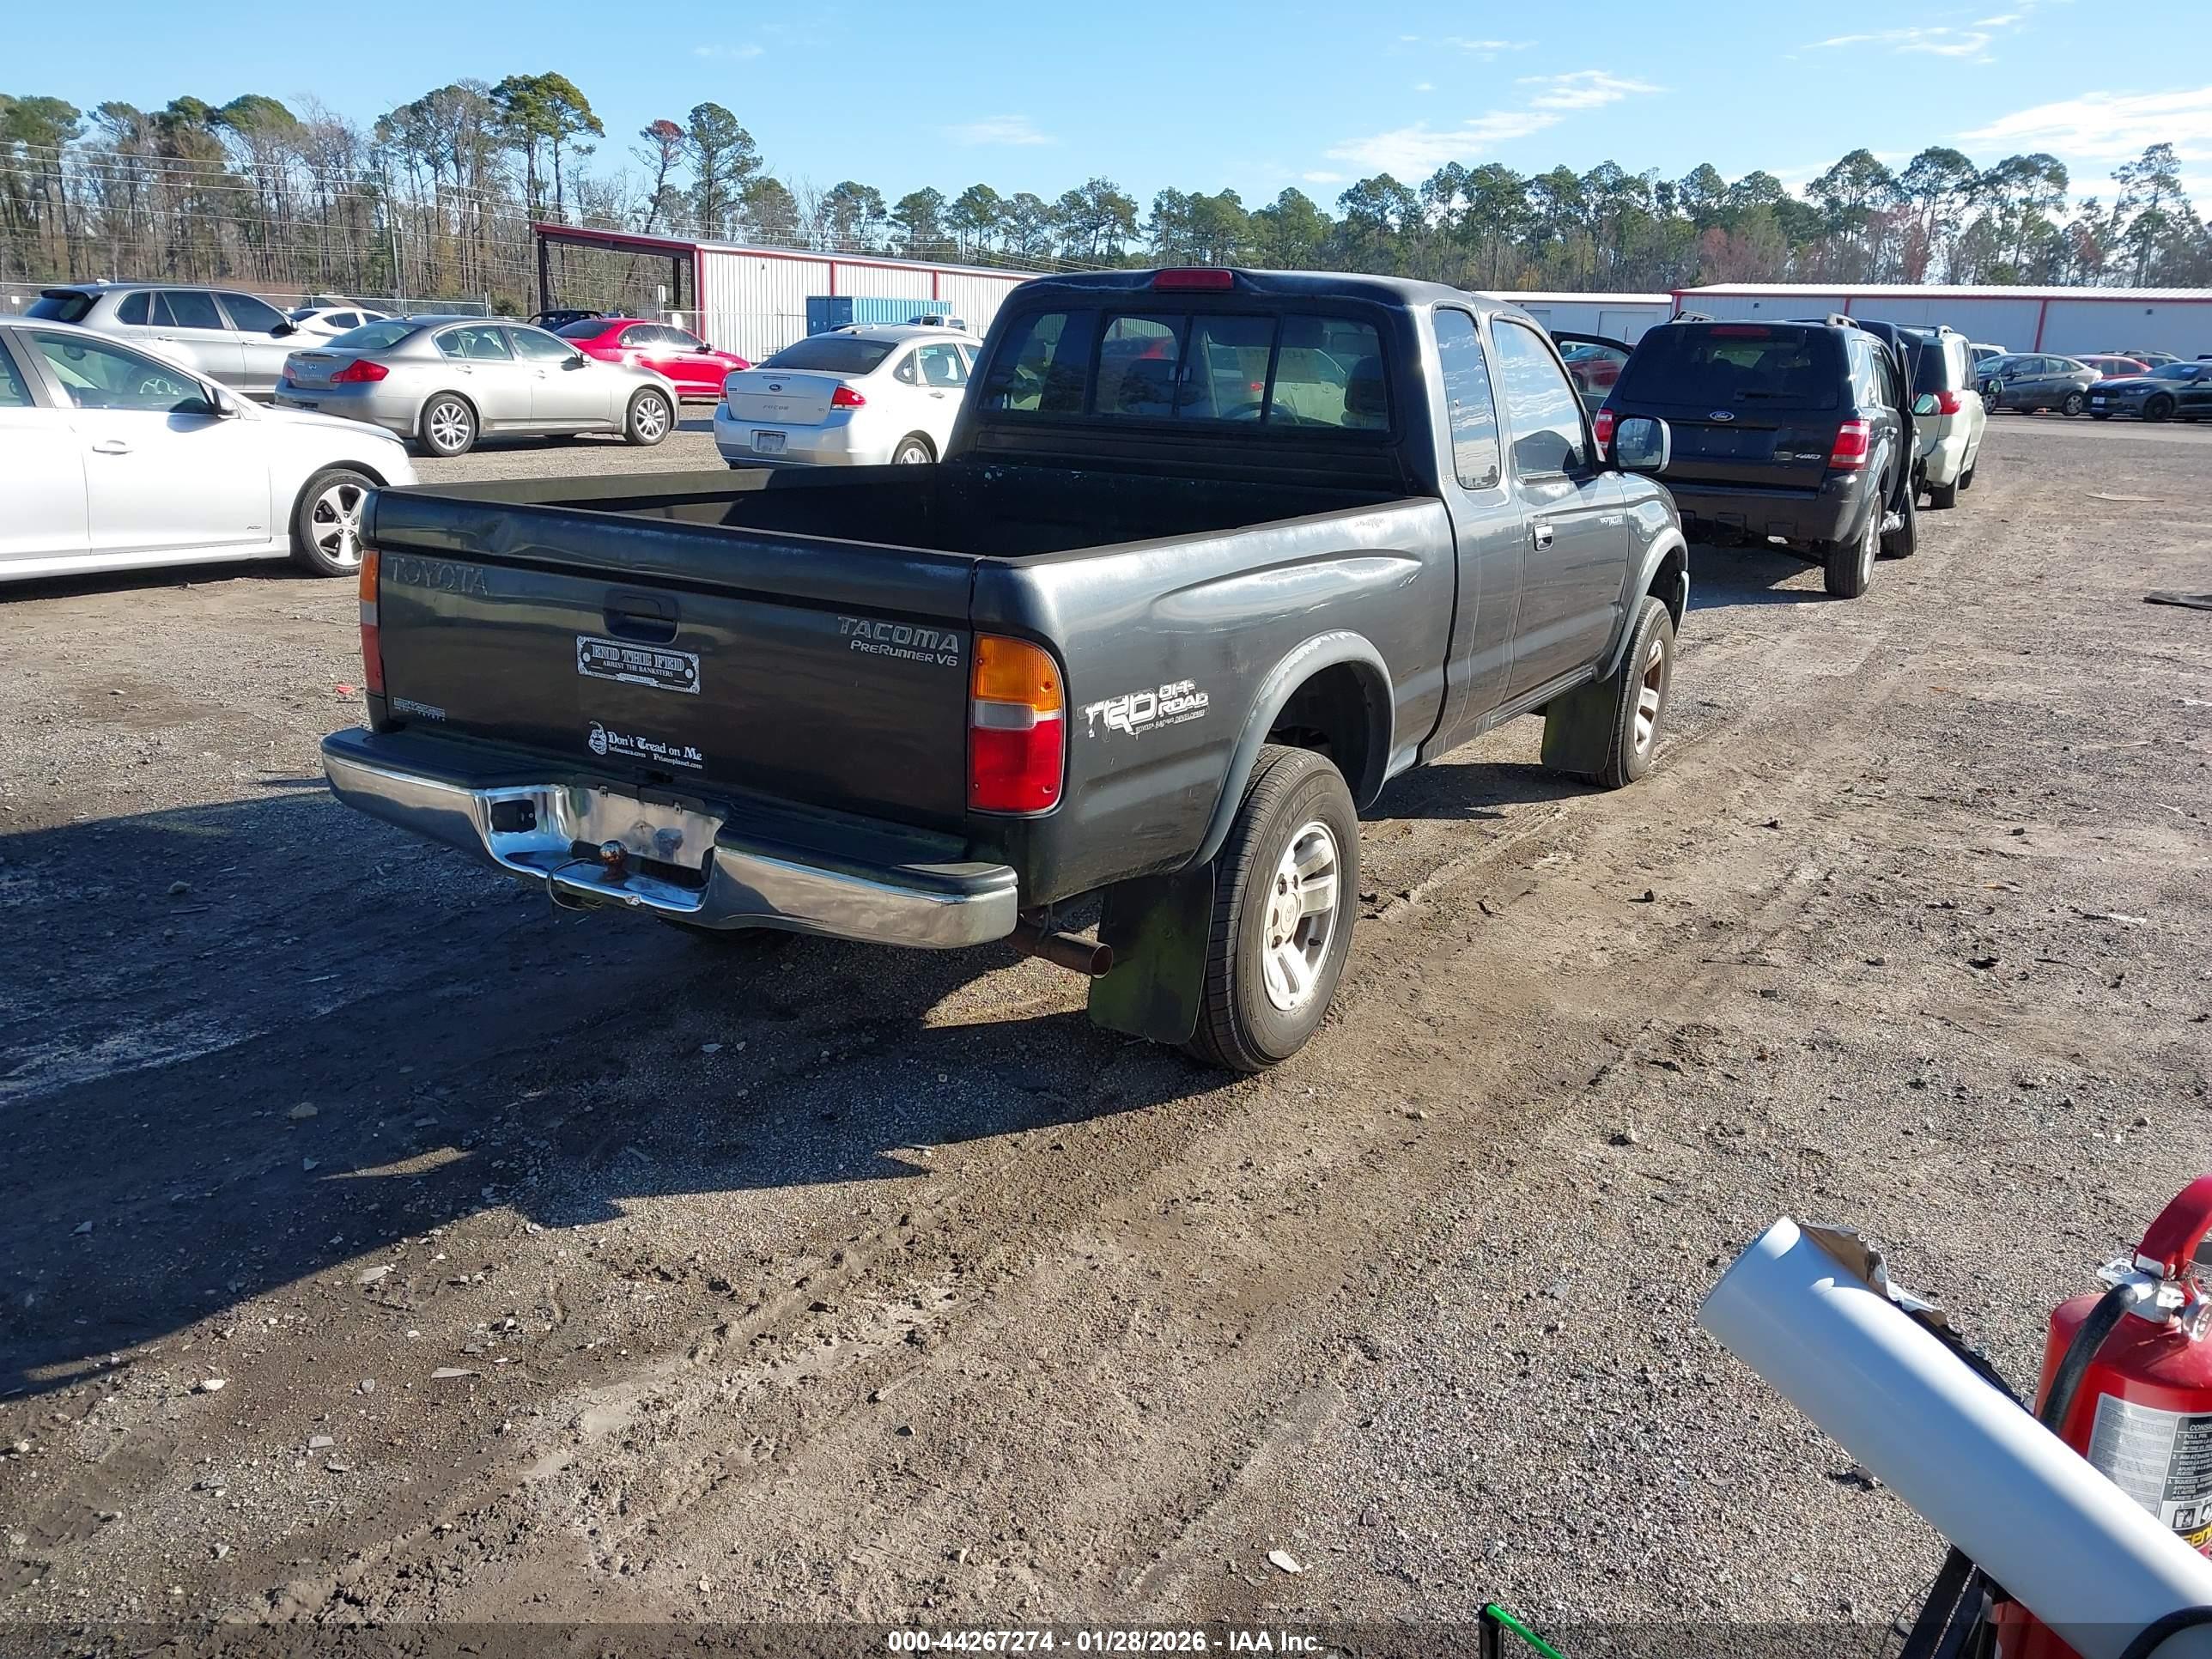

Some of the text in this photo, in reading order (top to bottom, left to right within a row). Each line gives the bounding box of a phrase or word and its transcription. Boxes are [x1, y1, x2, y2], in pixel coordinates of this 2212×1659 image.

[388, 556, 488, 596] TOYOTA
[838, 617, 958, 653] TACOMA
[591, 645, 684, 672] END THE FED
[602, 660, 624, 670] ARREST
[639, 665, 674, 678] BANKSTERS
[936, 653, 958, 667] V6
[1159, 693, 1209, 717] ROAD
[607, 731, 702, 761] Don't Tread on Me
